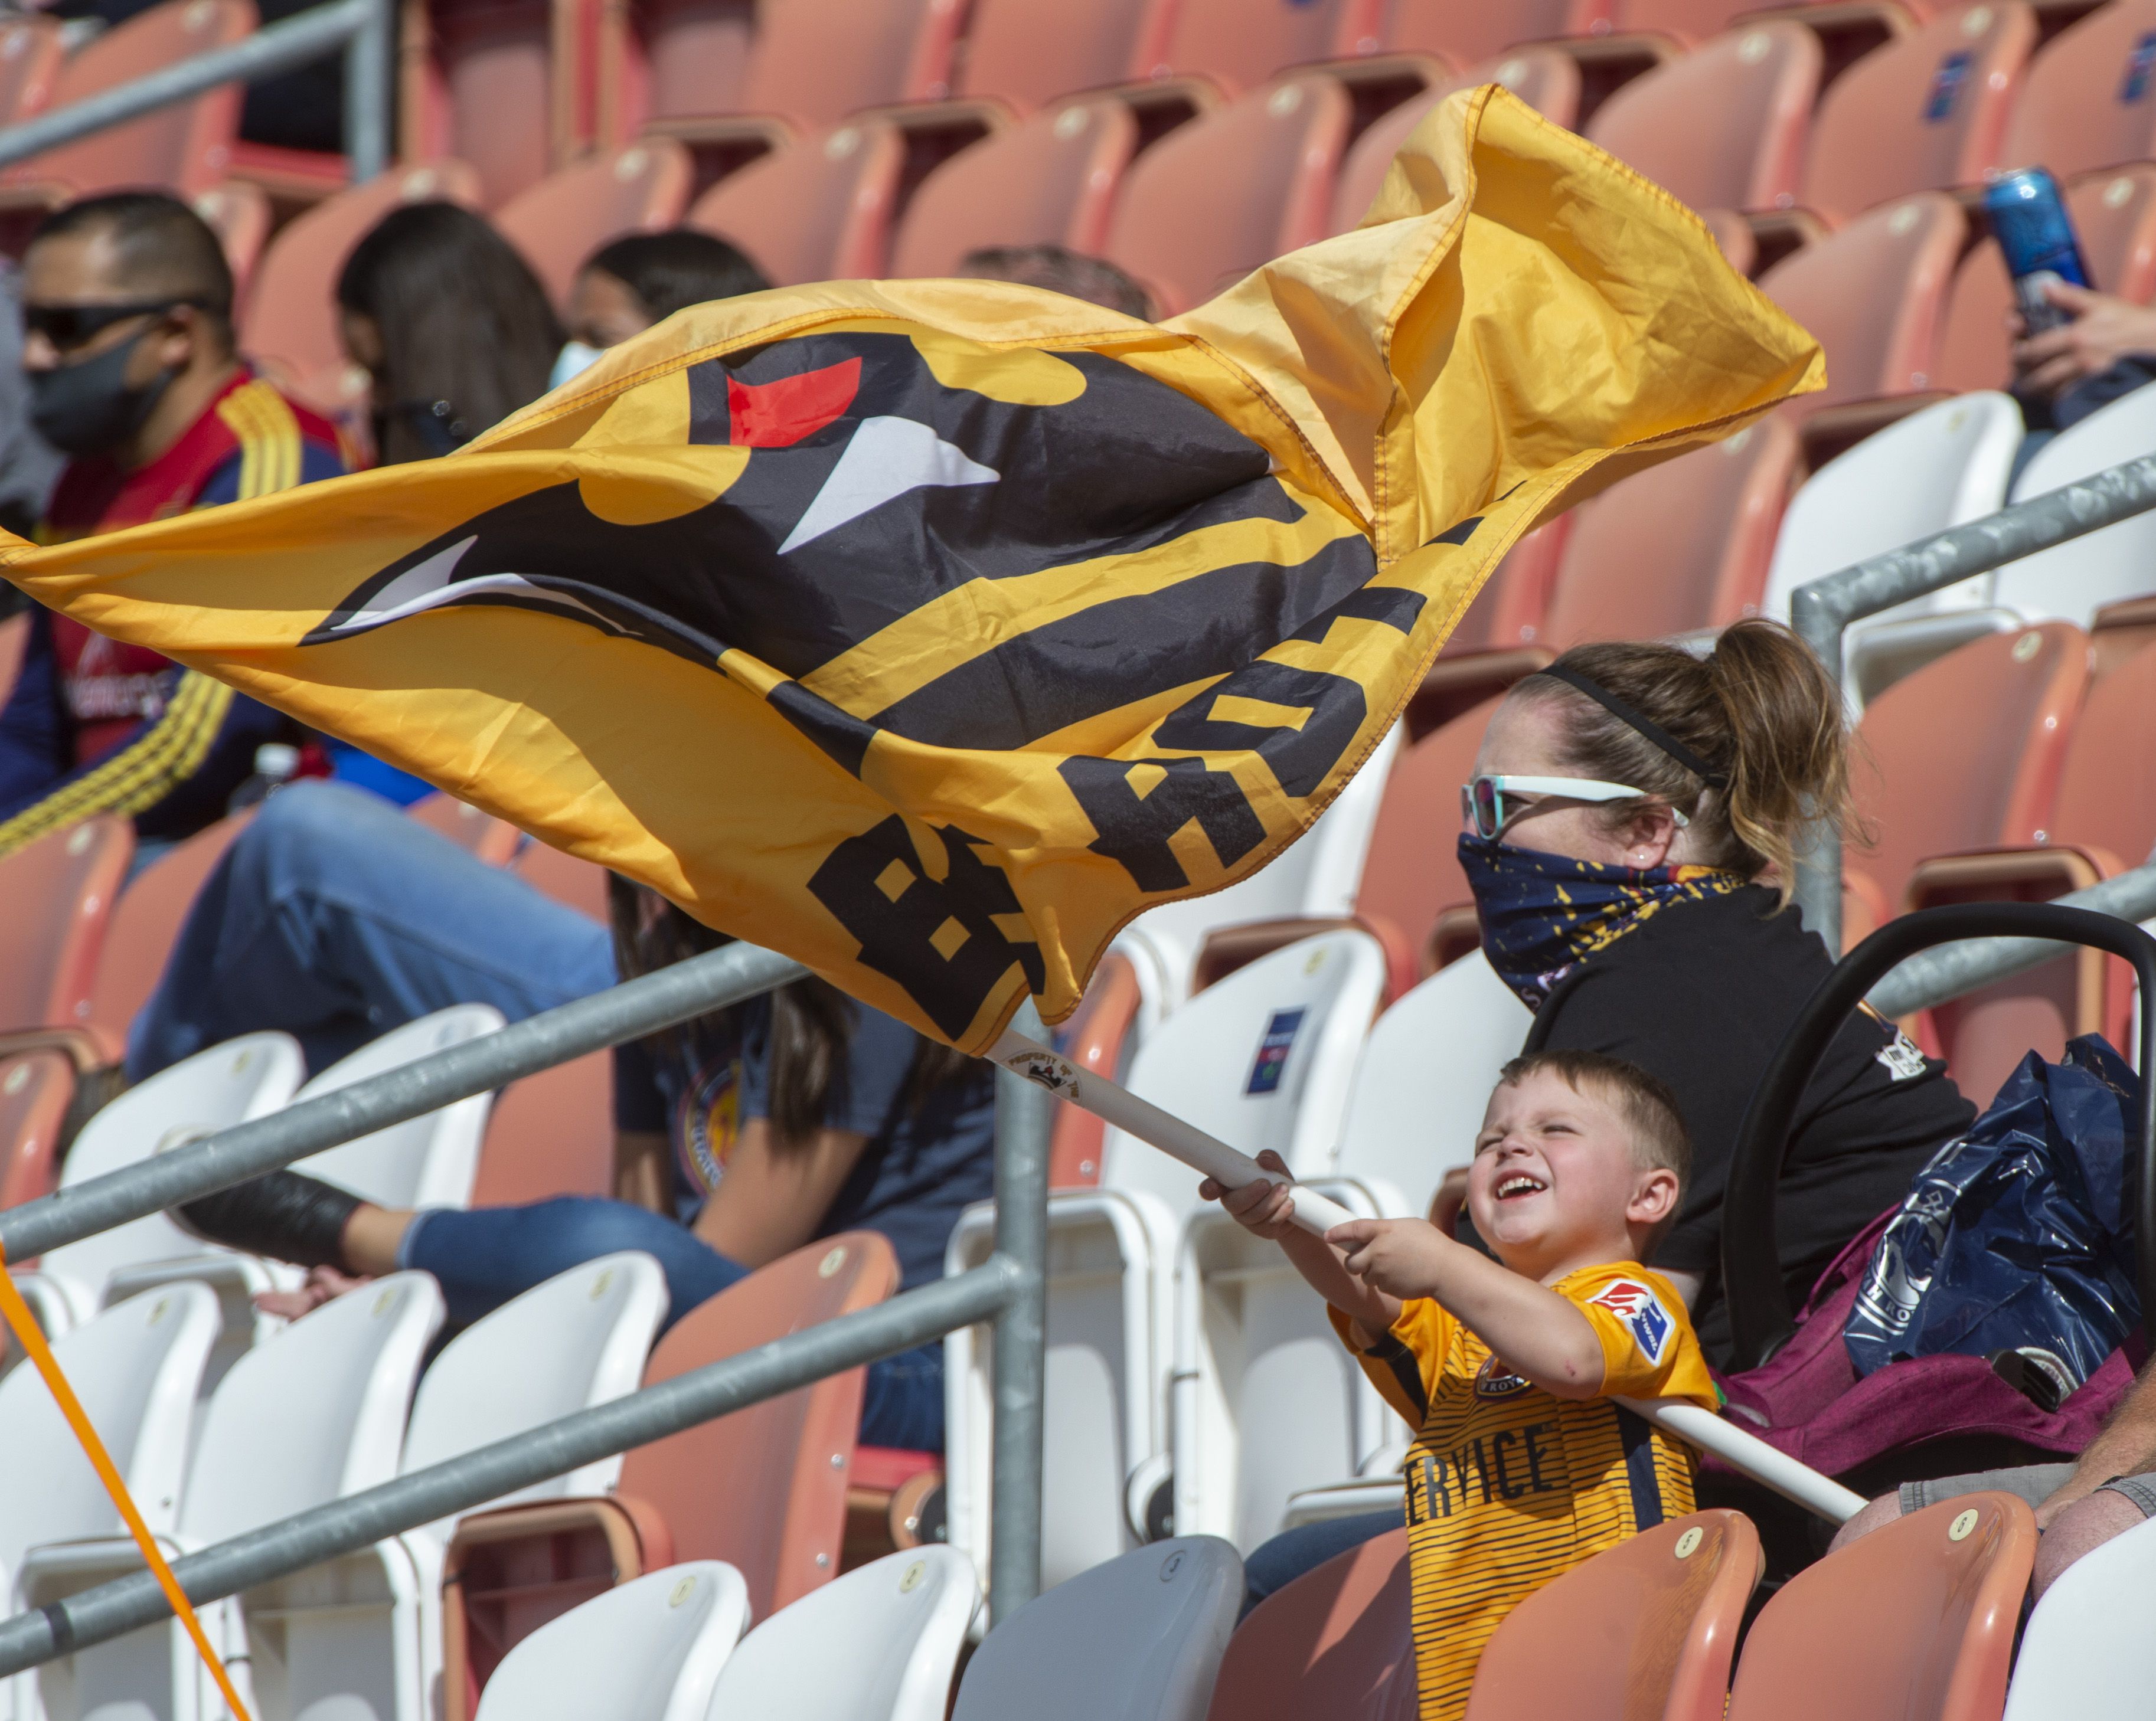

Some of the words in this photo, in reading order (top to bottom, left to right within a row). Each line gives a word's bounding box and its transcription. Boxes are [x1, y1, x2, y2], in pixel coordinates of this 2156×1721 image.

[1008, 1052, 1057, 1066] PROPERTY
[1060, 1064, 1072, 1077] OF
[1067, 1081, 1079, 1098] THE
